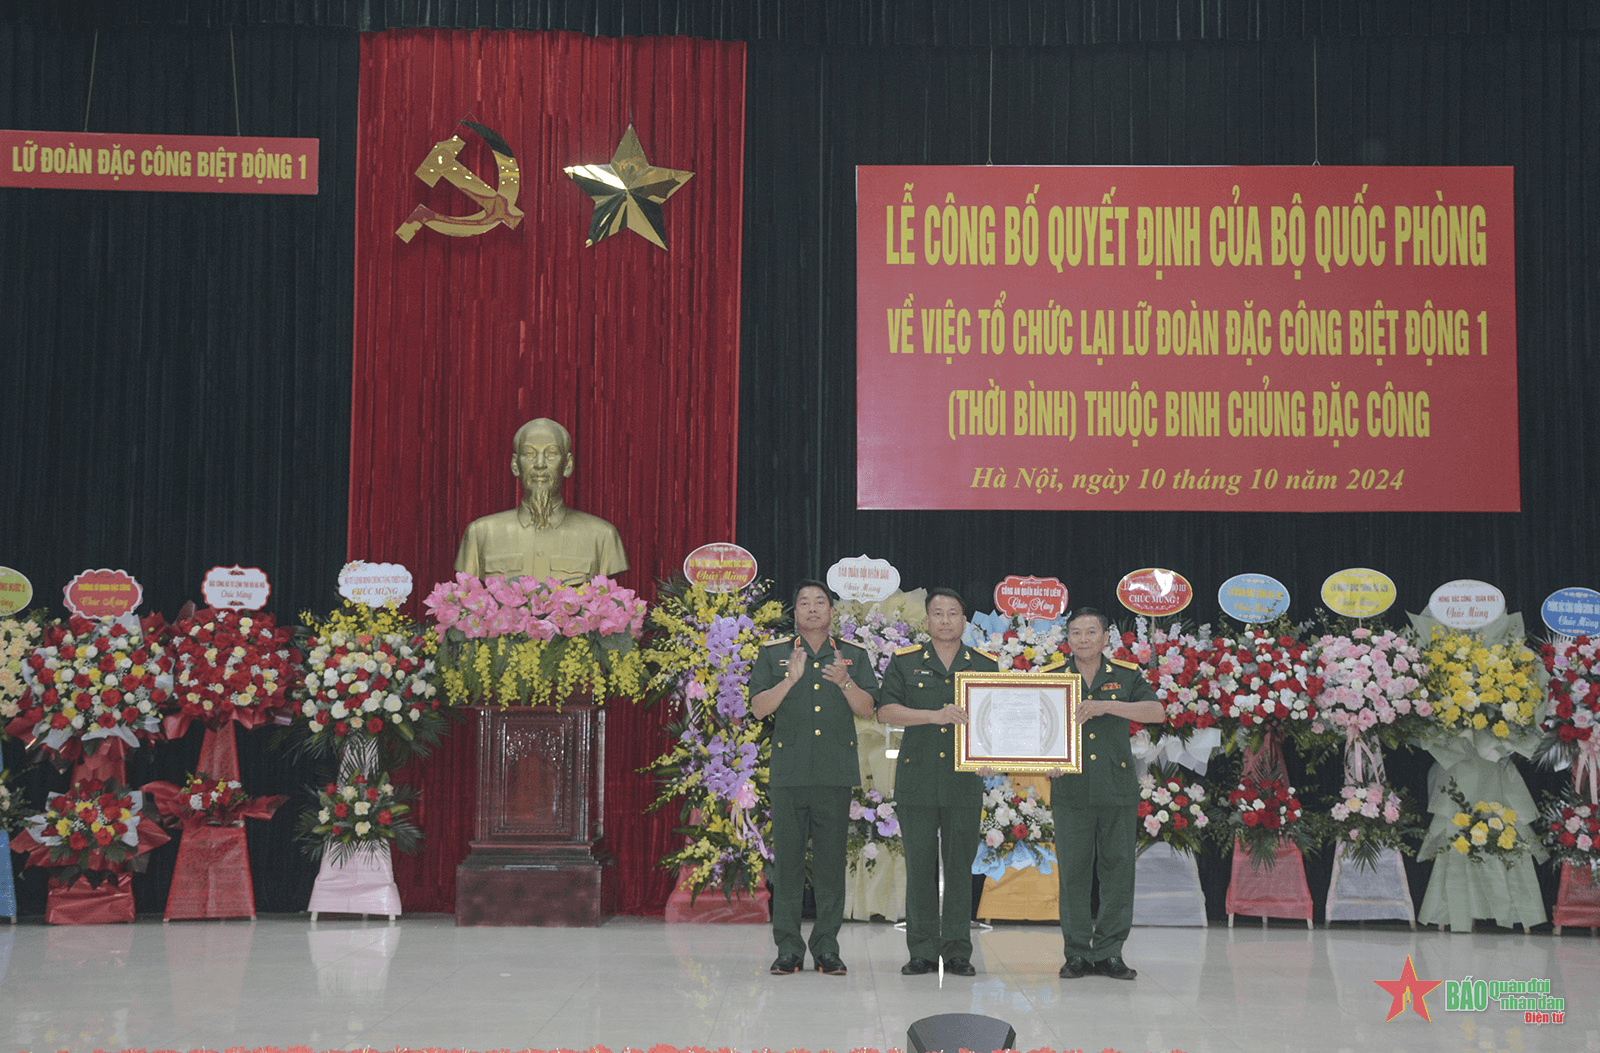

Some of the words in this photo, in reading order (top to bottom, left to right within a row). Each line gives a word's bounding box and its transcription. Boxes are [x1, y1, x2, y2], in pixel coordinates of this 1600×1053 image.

[13, 140, 38, 173] LỮ
[41, 143, 92, 174] ĐOÀN
[98, 144, 135, 180] ĐẶC
[141, 145, 191, 176] CÔNG
[198, 147, 237, 183] BIỆT
[242, 148, 292, 184] ĐỘNG
[298, 155, 306, 179] 1
[886, 183, 916, 264] LỄ
[924, 192, 996, 266] CÔNG
[1004, 184, 1041, 266] BỐ
[1047, 186, 1130, 273] QUYẾT
[1136, 206, 1201, 280] ĐỊNH
[1209, 185, 1264, 266] CỦA
[1270, 193, 1306, 280] BỘ
[1314, 184, 1386, 273] QUỐC
[1395, 191, 1487, 266] PHÒNG
[887, 293, 915, 355] VỀ
[921, 299, 972, 365] VIỆC
[977, 290, 1007, 356] TỔ
[1012, 299, 1074, 356] CHỨC
[1080, 310, 1115, 366] LẠI
[1121, 303, 1152, 356] LỮ
[1156, 299, 1219, 356] ĐOÀN
[1226, 300, 1272, 366] ĐẶC
[1279, 300, 1342, 356] CÔNG
[1350, 299, 1399, 366] BIỆT
[1405, 300, 1470, 366] ĐỘNG
[1477, 311, 1488, 356] 1
[948, 378, 1006, 440] (THỜI
[1013, 380, 1077, 442] BÌNH)
[1084, 381, 1159, 448] THUỘC
[1165, 391, 1220, 438] BINH
[1228, 374, 1305, 438] CHỦNG
[1312, 381, 1360, 448] ĐẶC
[1367, 381, 1431, 438] CÔNG
[970, 467, 1007, 489] Hà
[1013, 467, 1064, 494] Nội,
[1071, 467, 1131, 495] ngày
[1138, 468, 1166, 490] 10
[1173, 468, 1242, 496] tháng
[1251, 468, 1279, 490] 10
[1286, 469, 1338, 491] năm
[1345, 469, 1405, 491] 2024
[1001, 585, 1013, 595] CÔNG
[1014, 587, 1020, 595] AN
[1446, 606, 1465, 618] Chúc
[1468, 606, 1489, 620] Mừng
